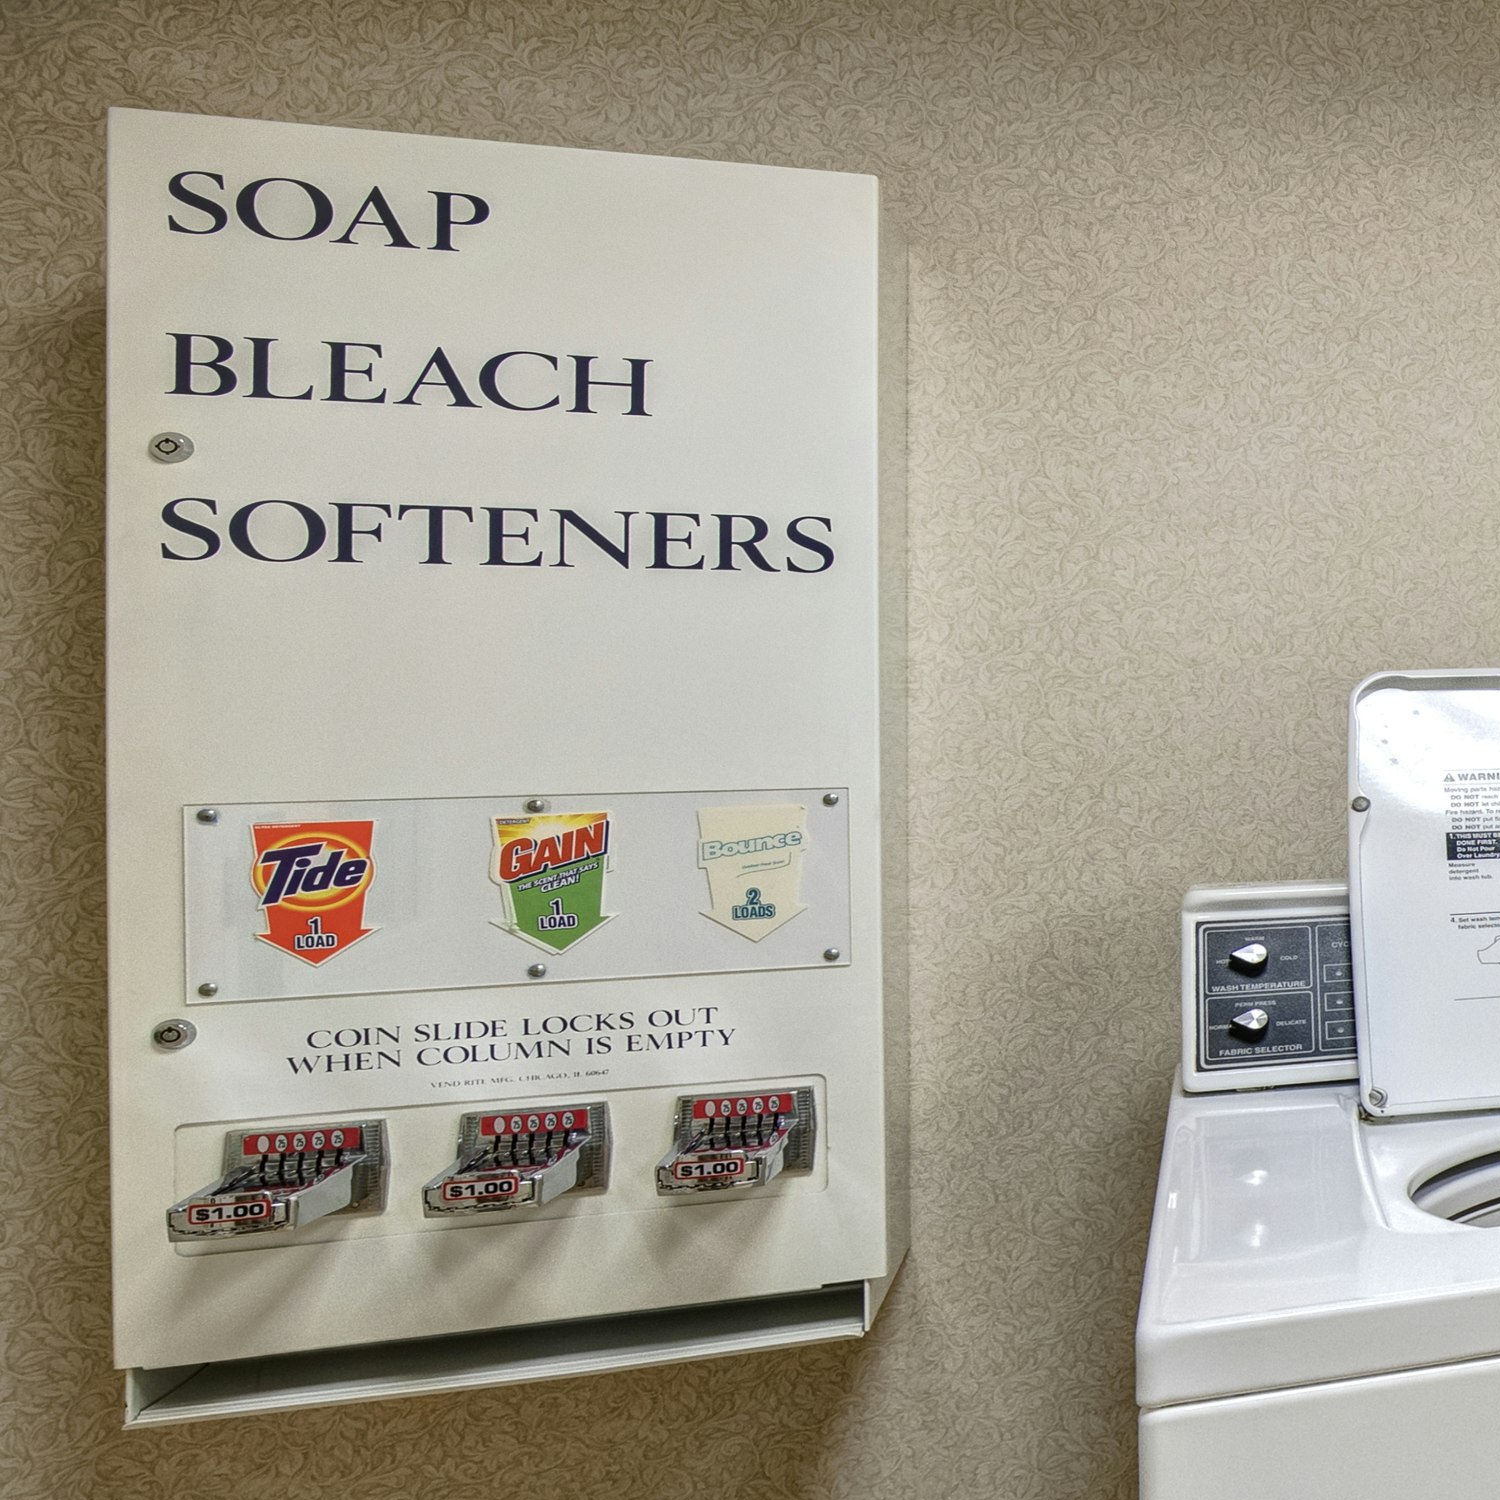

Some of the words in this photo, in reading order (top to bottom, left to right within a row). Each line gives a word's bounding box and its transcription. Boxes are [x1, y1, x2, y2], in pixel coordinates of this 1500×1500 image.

[166, 170, 490, 252] SOAP
[164, 331, 654, 418] BLEACH
[160, 496, 836, 574] SOFTENERS
[500, 821, 608, 882] GAIN
[702, 831, 802, 861] Bounce
[259, 842, 369, 907] Tide
[518, 883, 532, 891] THE
[533, 874, 557, 887] SCENT
[559, 868, 578, 881] THAT
[578, 862, 598, 874] SAYS
[541, 874, 580, 892] CLEAN!
[747, 888, 760, 905] 2
[551, 899, 561, 915] 1
[734, 905, 774, 919] LOADS
[308, 917, 321, 935] 1
[540, 916, 577, 929] LOAD
[296, 935, 335, 948] LOAD
[1211, 984, 1239, 992] WASH
[1240, 980, 1306, 990] TEMPERATURE
[306, 1026, 400, 1049] COIN
[414, 1019, 508, 1043] SLIDE
[522, 1011, 635, 1036] LOCKS
[648, 1006, 718, 1028] OUT
[286, 1050, 401, 1075] WHEN
[416, 1039, 571, 1066] COLUMN
[586, 1036, 612, 1055] IS
[626, 1028, 736, 1053] EMPTY
[1218, 1048, 1253, 1056] FABRIC
[1255, 1044, 1303, 1054] SELECTOR
[430, 1080, 461, 1089] VEND
[464, 1078, 486, 1086] RITE
[518, 1072, 571, 1082] CHICAGO,
[723, 1104, 730, 1112] 25
[739, 1103, 746, 1111] 25
[755, 1102, 762, 1110] 25
[771, 1100, 778, 1109] 25
[512, 1120, 521, 1129] 25
[529, 1119, 538, 1128] 25
[547, 1118, 555, 1127] 25
[564, 1116, 573, 1125] 25
[277, 1139, 287, 1148] 25
[295, 1138, 305, 1147] 25
[314, 1136, 324, 1145] 25
[333, 1135, 343, 1144] 25
[681, 1161, 738, 1177] $1.00
[450, 1180, 513, 1197] $1.00
[195, 1203, 264, 1221] $1.00
